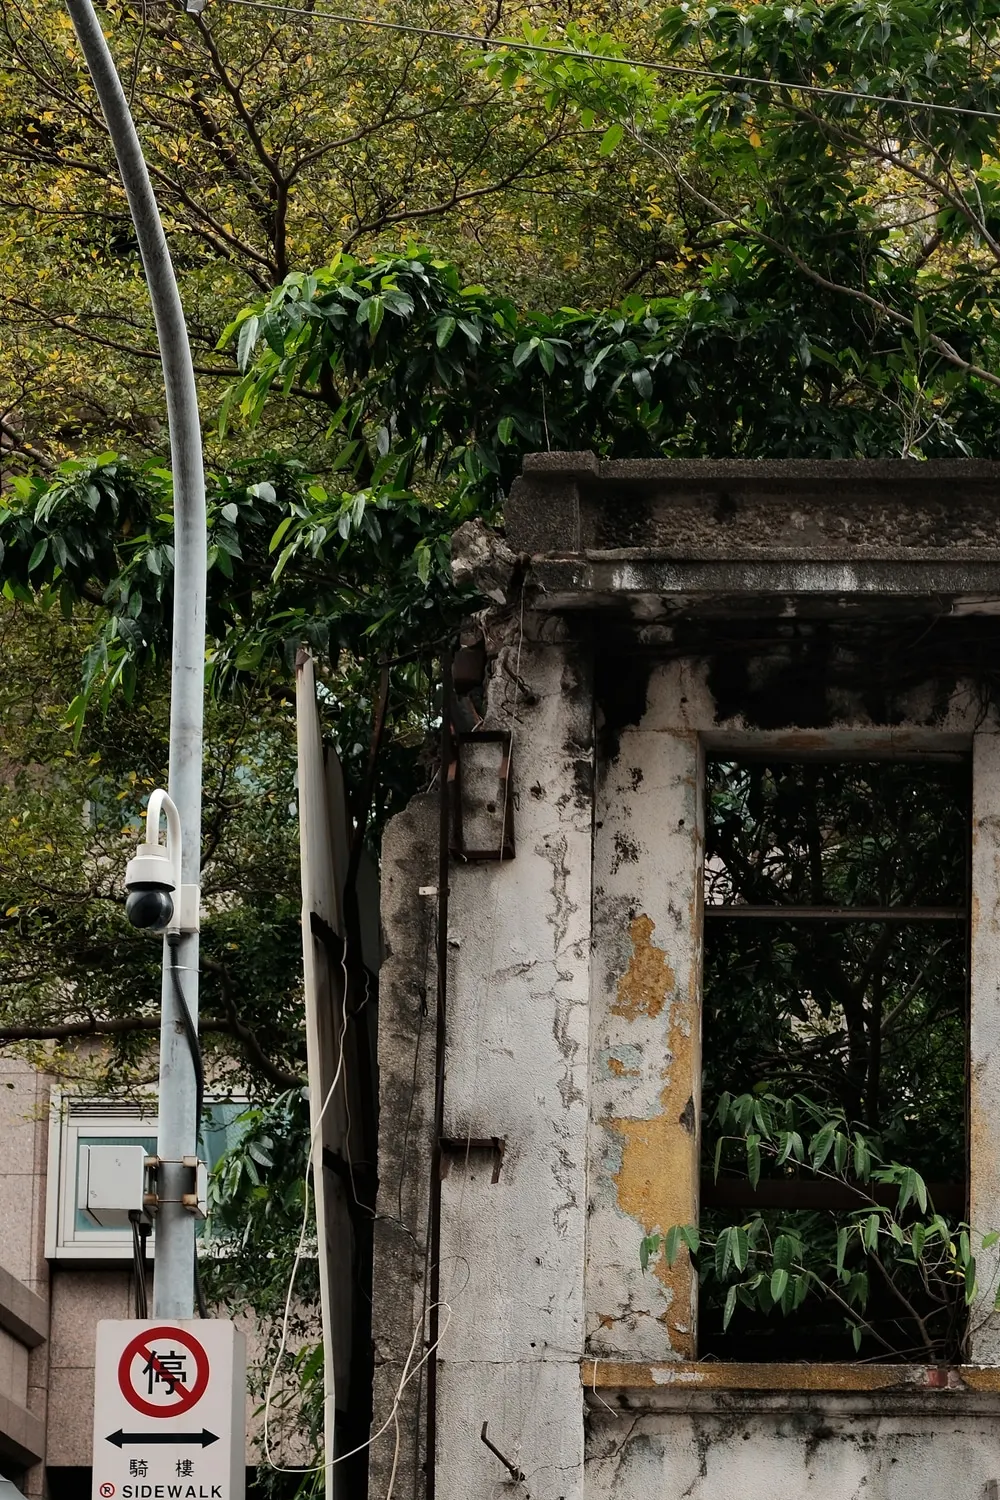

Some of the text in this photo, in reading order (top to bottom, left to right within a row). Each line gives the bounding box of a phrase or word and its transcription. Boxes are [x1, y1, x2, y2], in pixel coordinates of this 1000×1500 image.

[142, 1350, 187, 1395] 停
[129, 1459, 195, 1478] 騎樓
[122, 1485, 222, 1499] SIDEWALK
